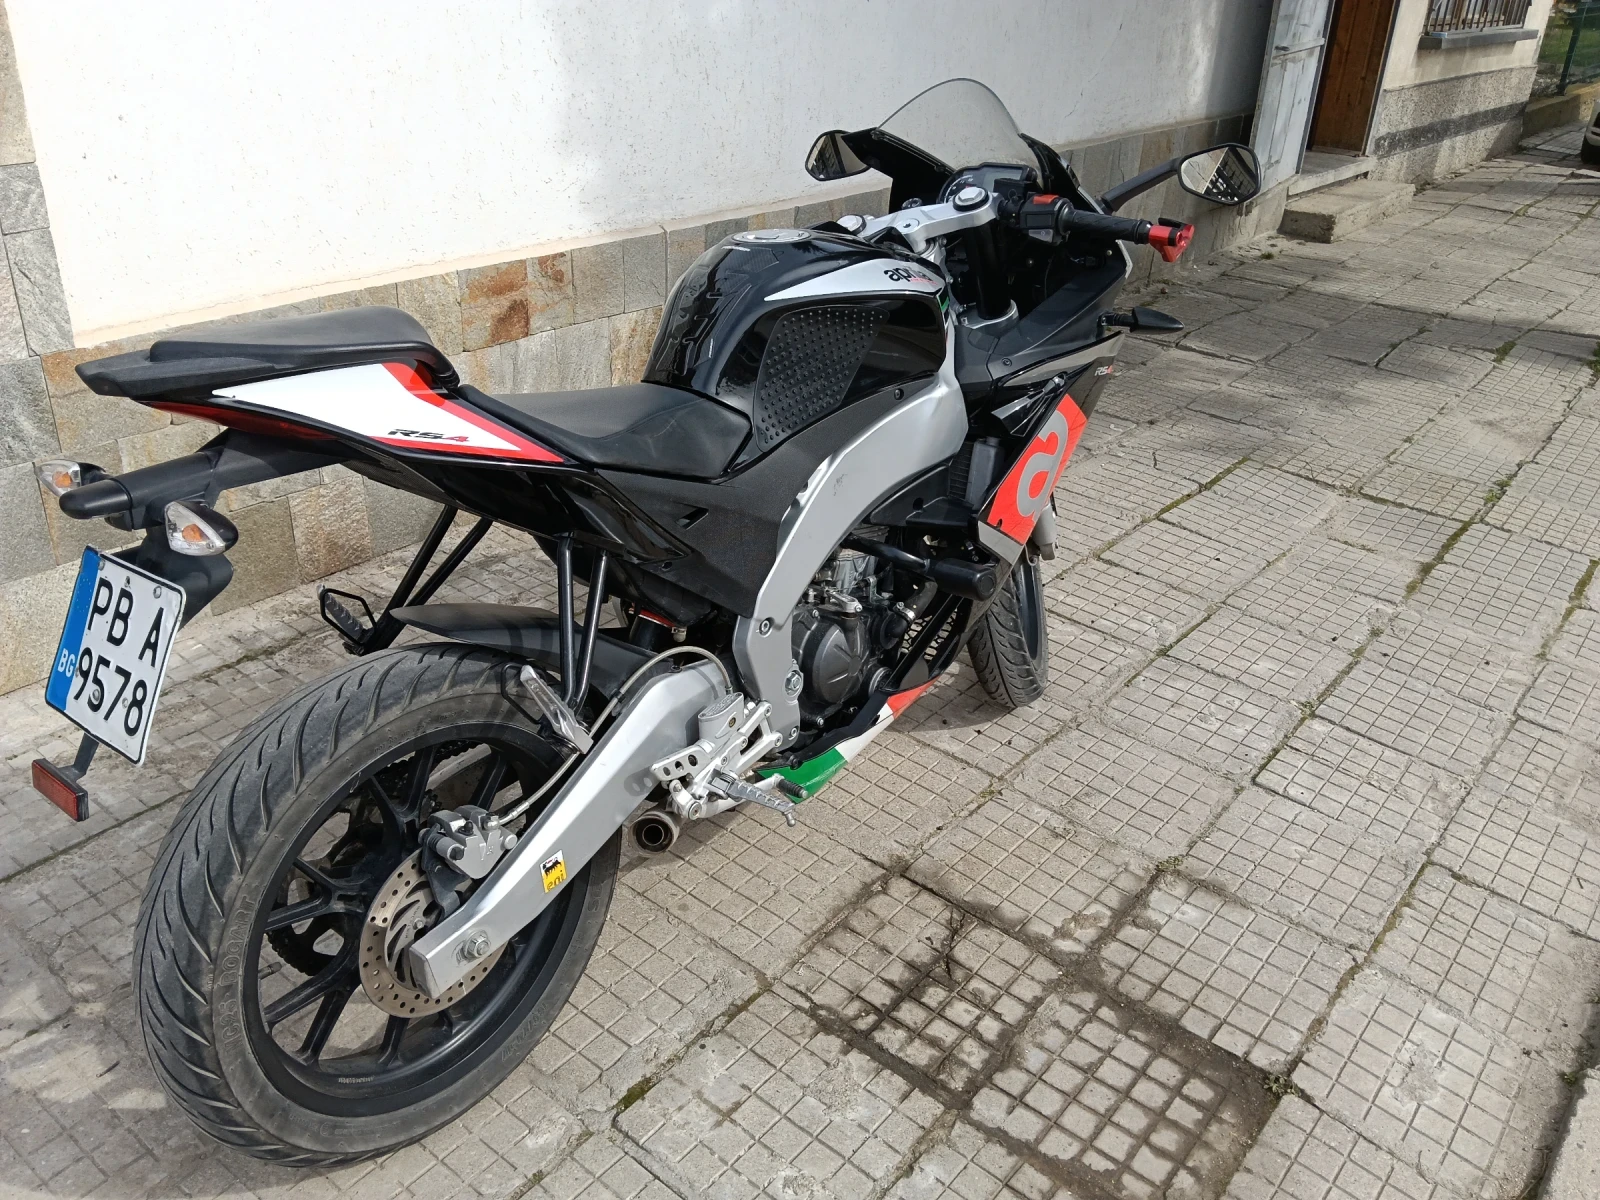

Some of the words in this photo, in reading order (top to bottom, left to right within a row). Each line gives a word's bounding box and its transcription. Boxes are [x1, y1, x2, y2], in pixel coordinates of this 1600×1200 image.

[387, 429, 469, 443] RS4
[57, 648, 76, 678] BG
[73, 647, 148, 737] 9578
[547, 869, 564, 891] eni
